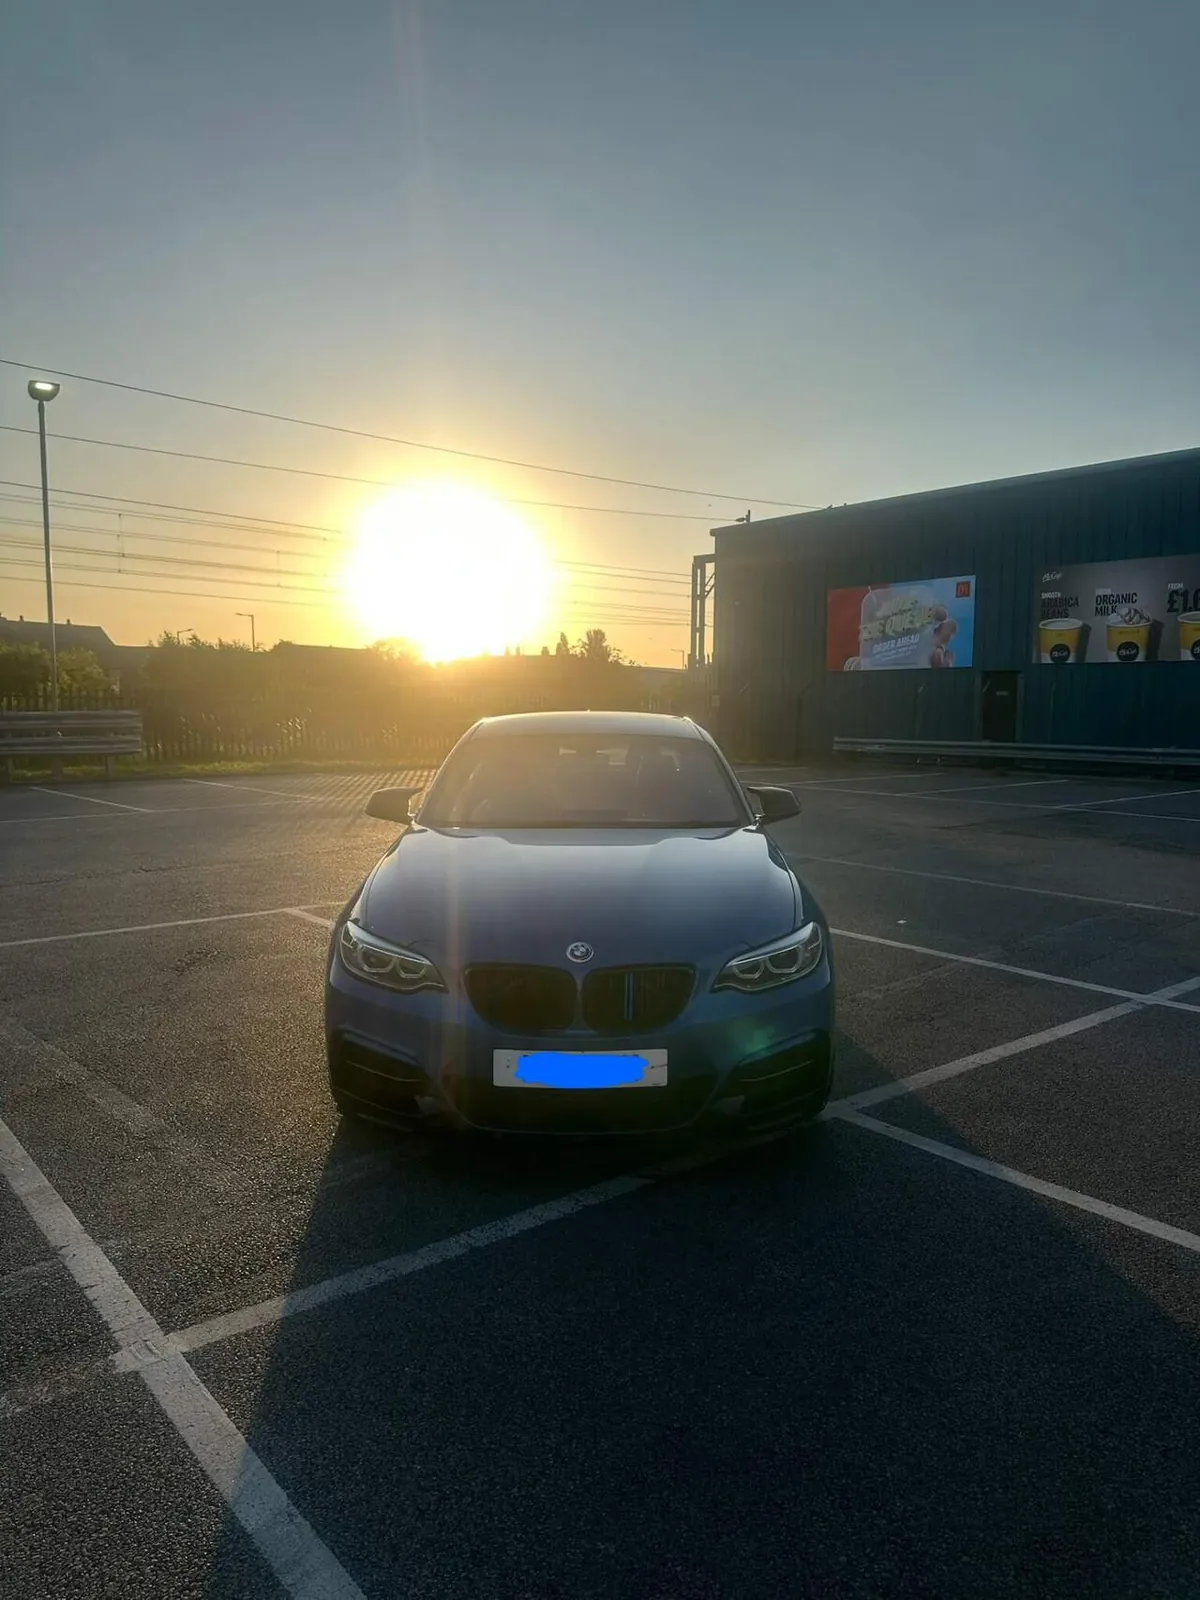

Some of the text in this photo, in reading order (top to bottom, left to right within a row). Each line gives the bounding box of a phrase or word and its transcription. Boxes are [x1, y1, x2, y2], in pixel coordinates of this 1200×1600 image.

[1167, 582, 1184, 590] FROM
[1041, 596, 1080, 609] ARABICA
[1095, 592, 1138, 606] ORGANIC
[1095, 605, 1118, 616] MILK
[896, 633, 920, 648] AHEAD
